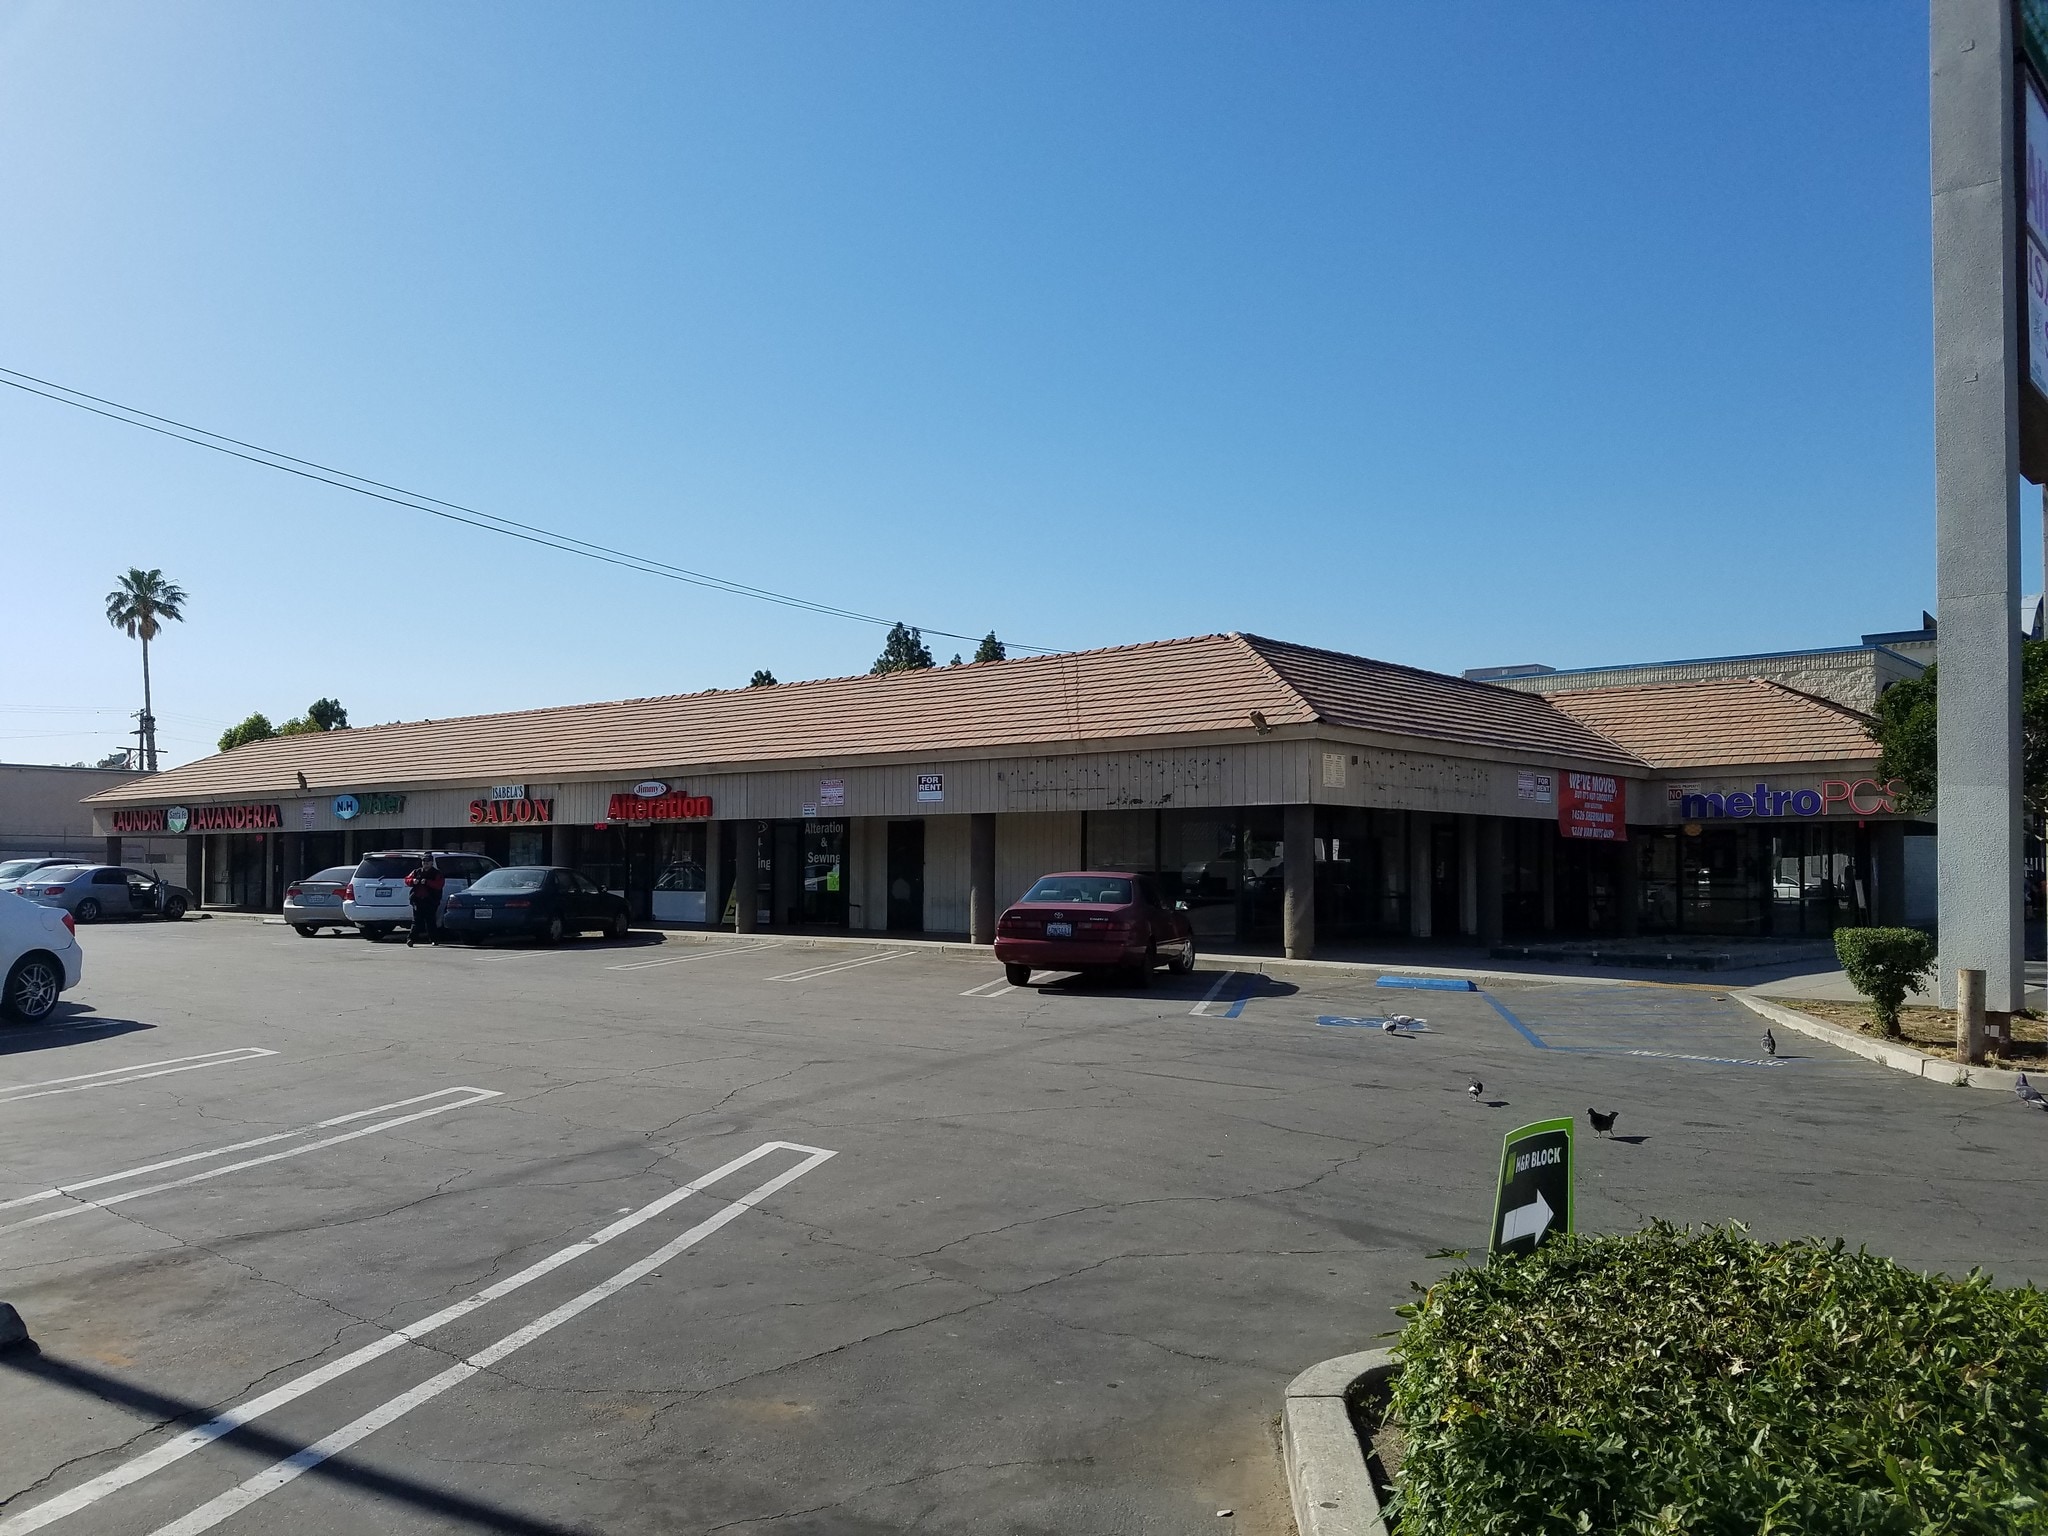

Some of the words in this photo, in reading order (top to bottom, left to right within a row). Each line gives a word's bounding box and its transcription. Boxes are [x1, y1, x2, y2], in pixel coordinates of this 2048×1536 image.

[922, 776, 940, 784] FOR
[1538, 777, 1549, 785] FOR
[1570, 772, 1591, 790] WE'VE
[492, 785, 524, 799] ISABELA'S
[636, 783, 666, 795] Jimmy's
[920, 784, 942, 792] RENT
[1669, 790, 1682, 800] NO
[469, 799, 550, 824] SALON
[608, 792, 712, 820] Alteration
[111, 810, 165, 832] LAUNDRY
[190, 804, 280, 830] LAVANDERIA
[820, 837, 829, 848] &
[1515, 1153, 1531, 1174] H&R
[1530, 1147, 1562, 1168] BLOCK
